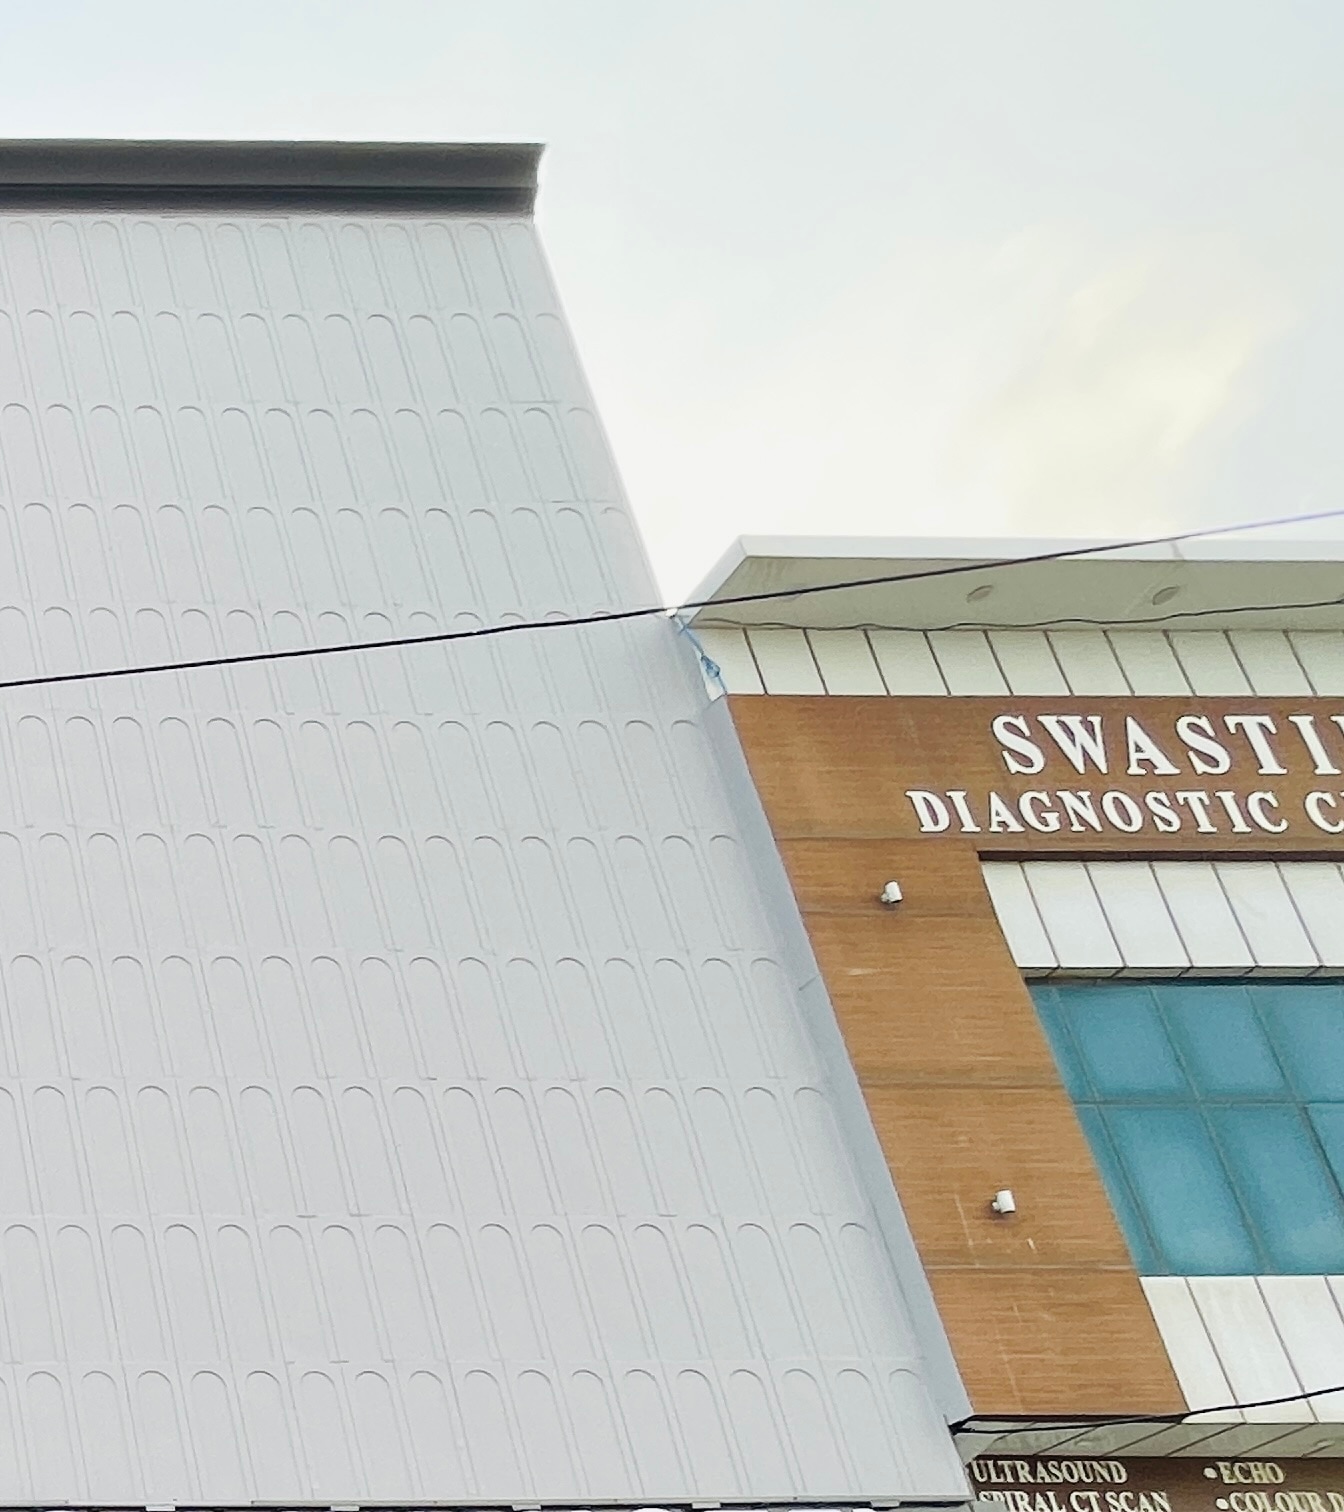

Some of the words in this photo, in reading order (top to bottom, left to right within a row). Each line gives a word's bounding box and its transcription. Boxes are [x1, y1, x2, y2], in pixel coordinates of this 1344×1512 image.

[991, 714, 1344, 776] SWASTI
[905, 790, 1288, 834] DIAGNOSTIC
[1305, 790, 1344, 834] C
[970, 1460, 1128, 1484] ULTRASOUND
[1216, 1461, 1286, 1484] ECHO
